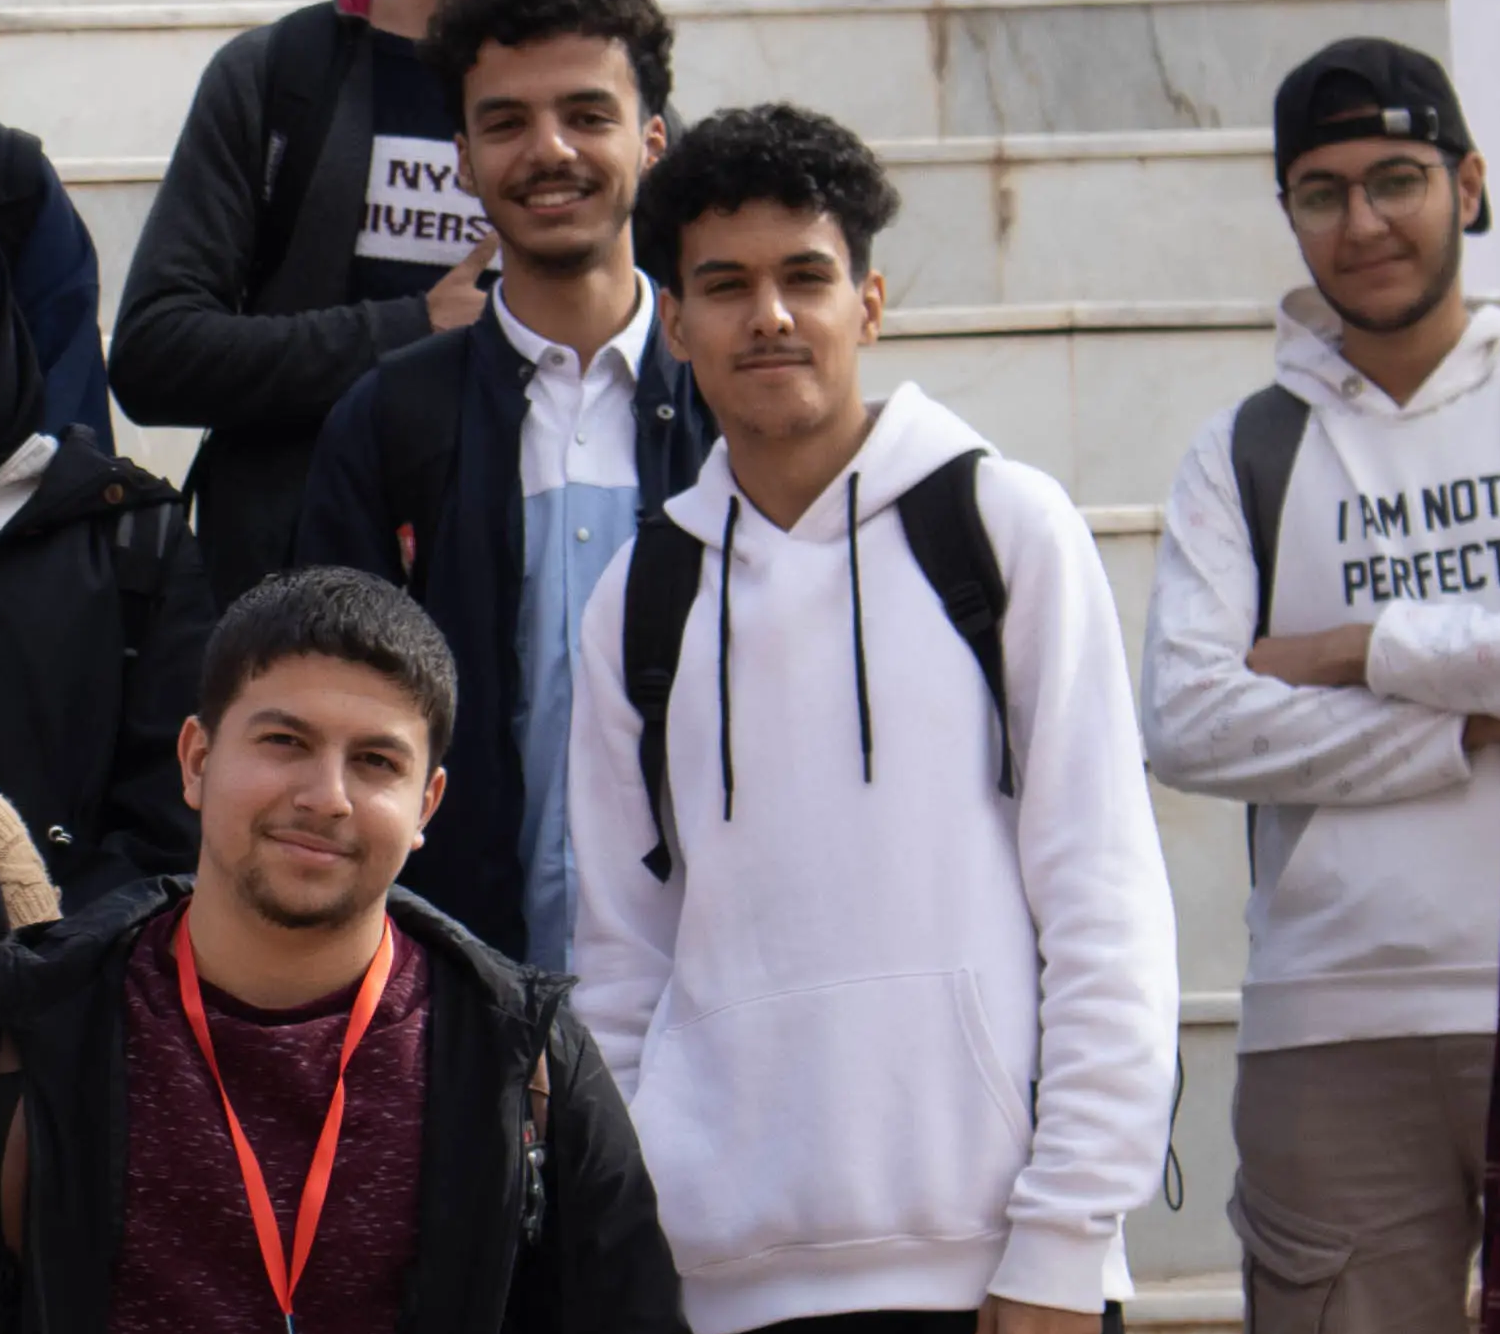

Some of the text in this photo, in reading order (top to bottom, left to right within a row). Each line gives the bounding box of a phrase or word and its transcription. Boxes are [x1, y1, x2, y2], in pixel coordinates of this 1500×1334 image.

[388, 159, 459, 193] NY
[358, 204, 494, 244] IVERS
[1336, 500, 1349, 543] I
[1358, 493, 1410, 538] AM
